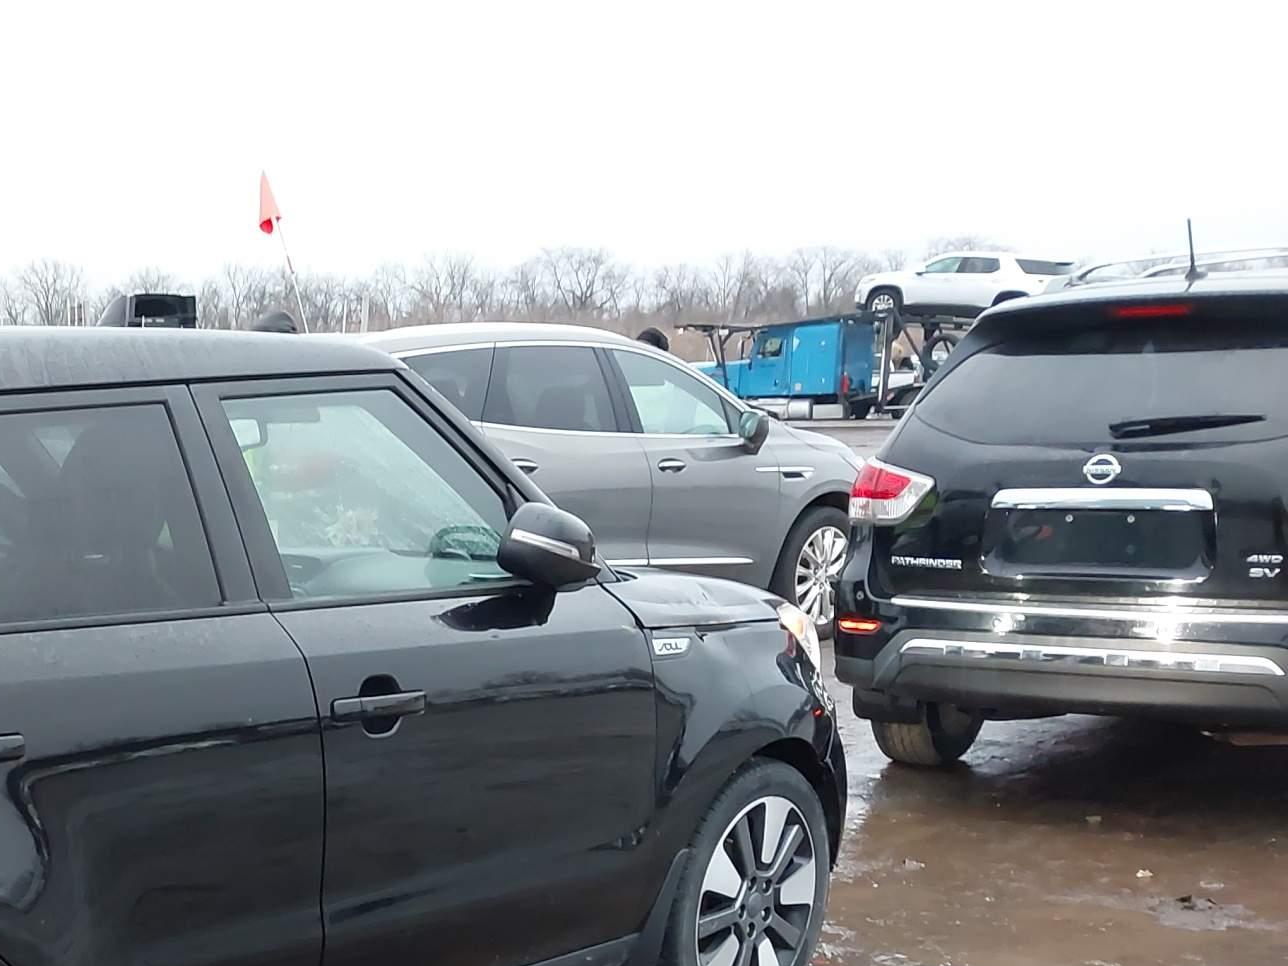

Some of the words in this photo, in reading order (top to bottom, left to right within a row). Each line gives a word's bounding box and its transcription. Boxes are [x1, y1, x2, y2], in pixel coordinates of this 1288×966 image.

[891, 555, 963, 570] PATHFINDER
[1246, 554, 1284, 564] 4WD
[1248, 567, 1281, 578] SV
